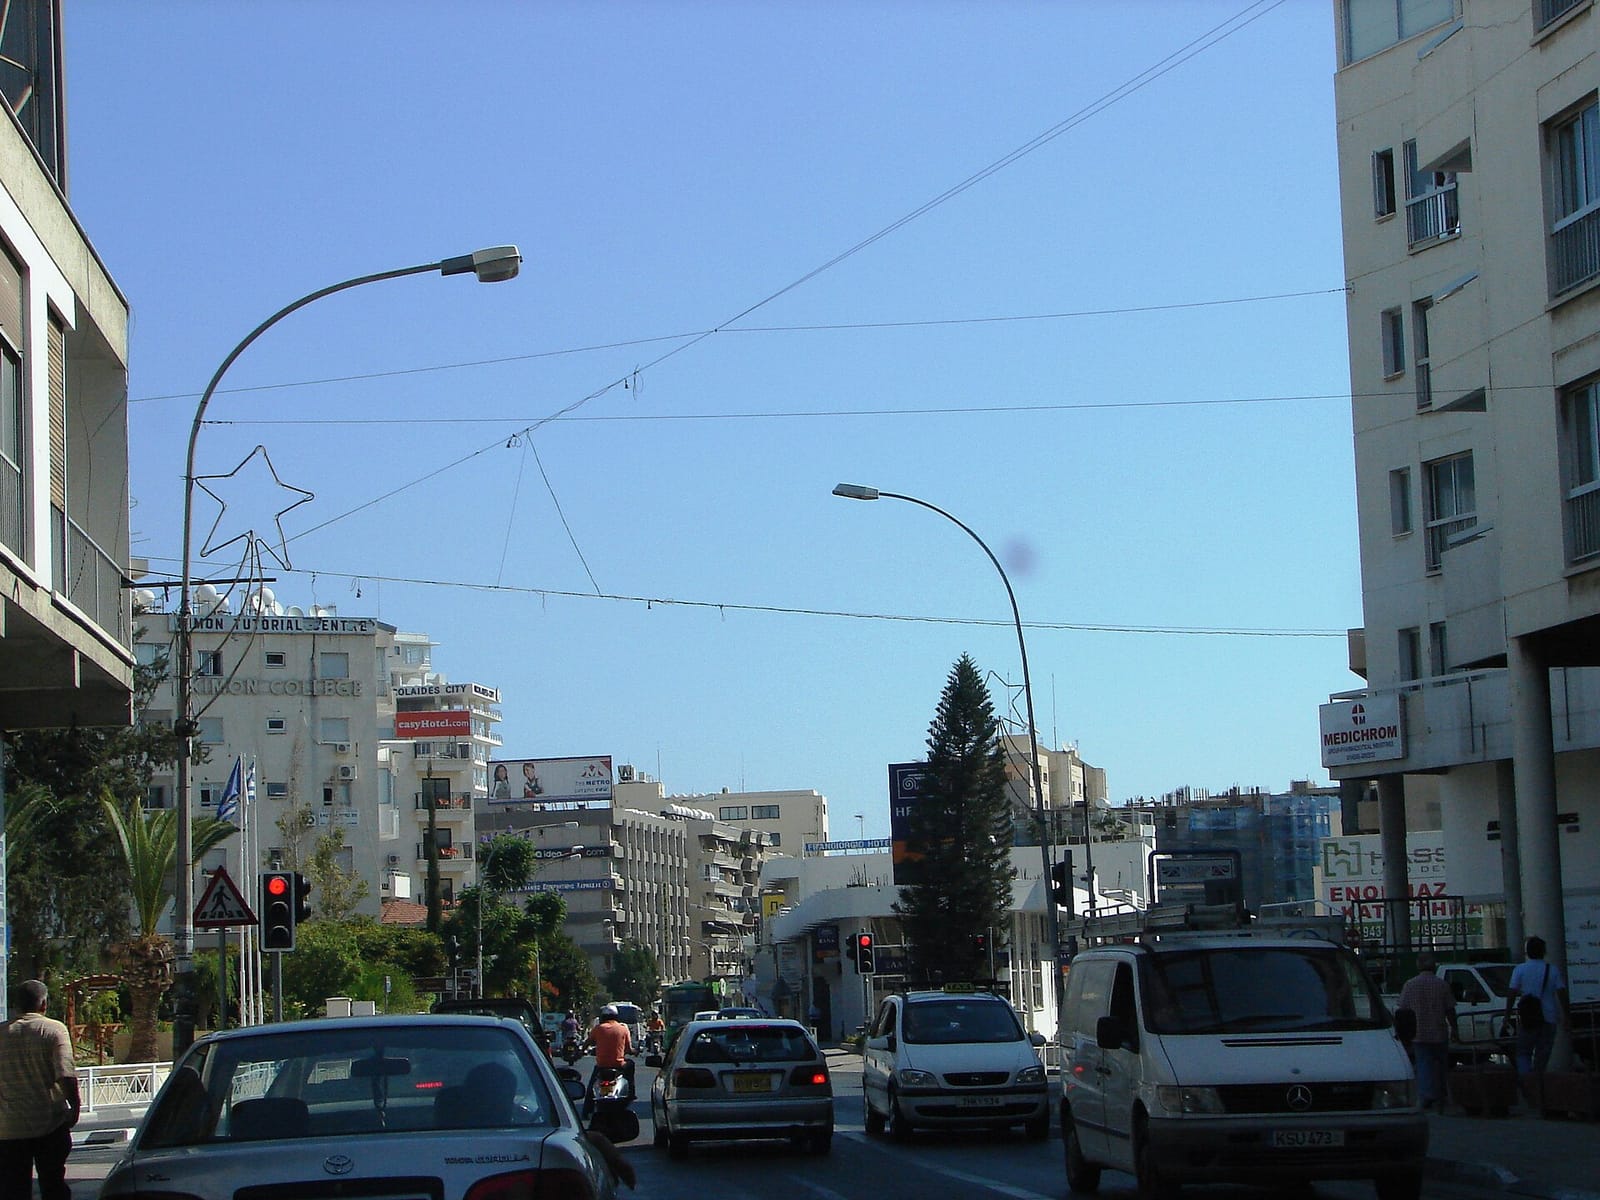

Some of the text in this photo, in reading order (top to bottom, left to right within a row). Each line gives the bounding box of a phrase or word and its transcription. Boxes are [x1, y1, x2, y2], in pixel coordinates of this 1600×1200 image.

[179, 619, 224, 631] IMON
[234, 618, 302, 631] TUTORIAL
[191, 678, 363, 697] KIMON COLLEGE
[445, 684, 467, 694] CITY
[398, 718, 469, 731] easyHotel.com
[1323, 725, 1398, 746] MEDICHROM
[868, 839, 889, 848] HOTE
[1275, 1130, 1333, 1145] KSU 473
